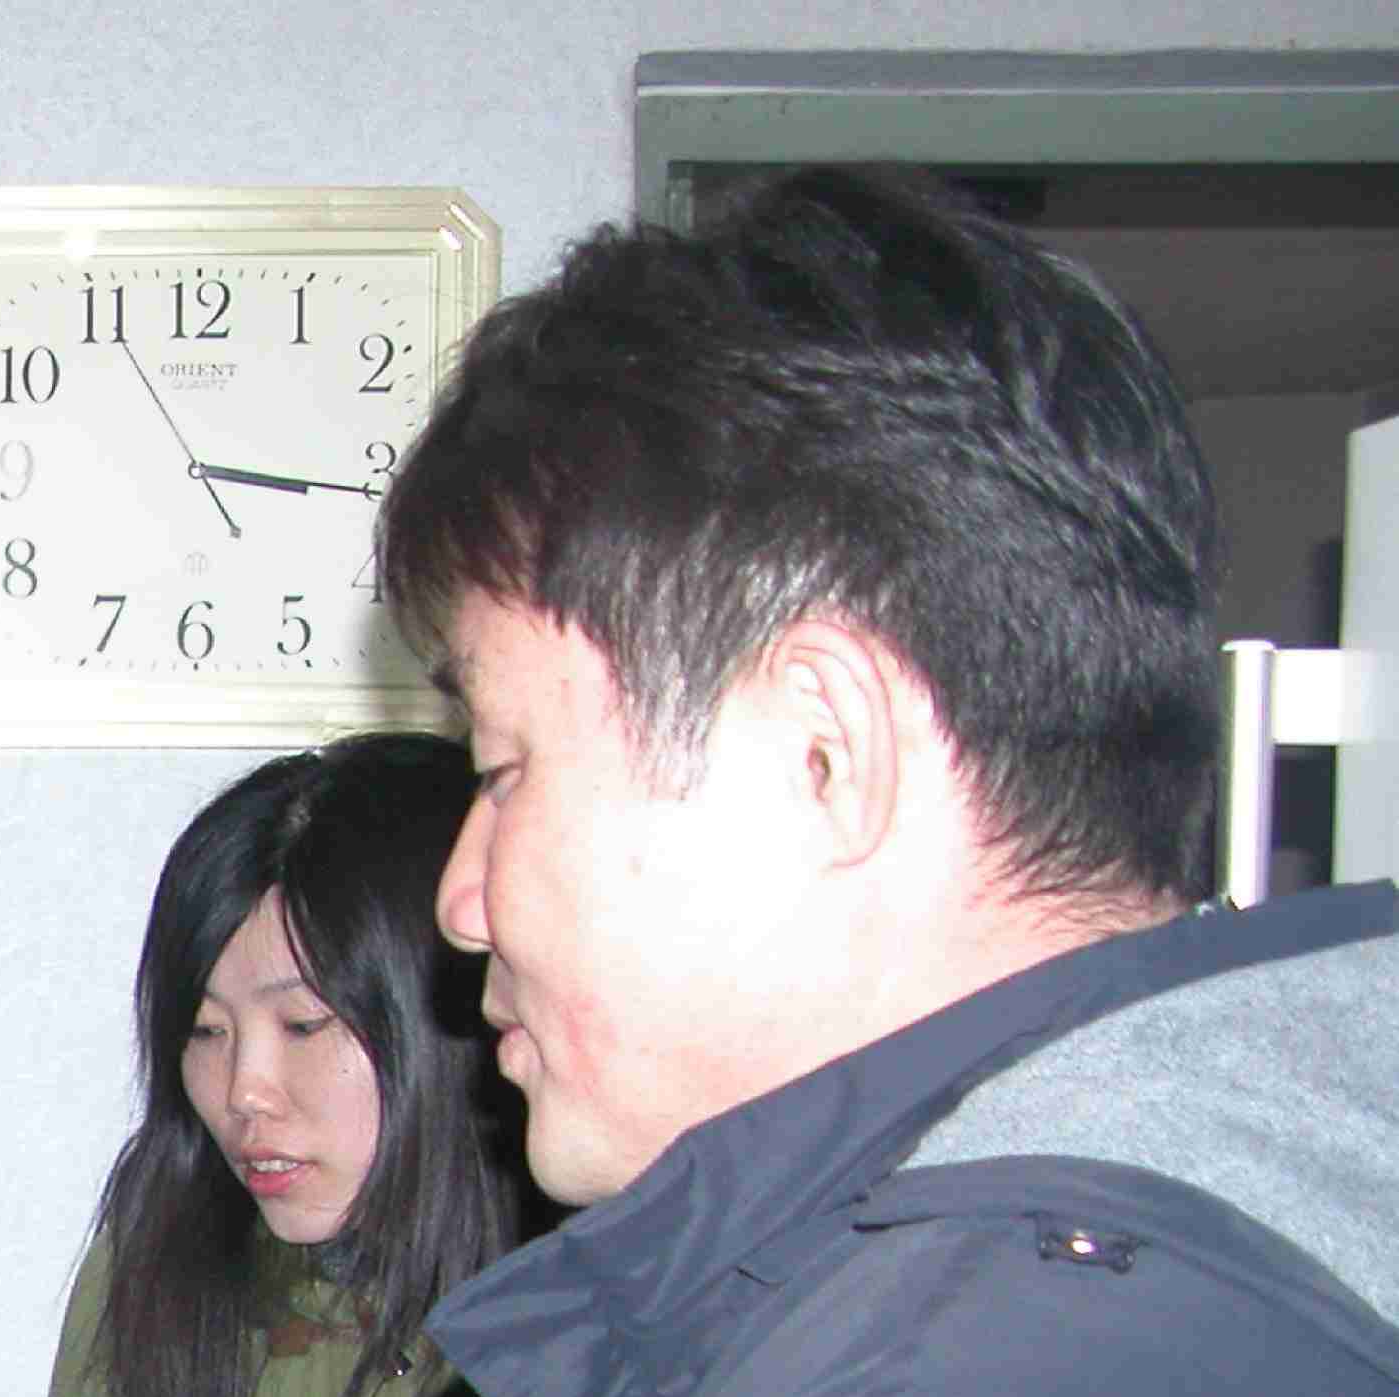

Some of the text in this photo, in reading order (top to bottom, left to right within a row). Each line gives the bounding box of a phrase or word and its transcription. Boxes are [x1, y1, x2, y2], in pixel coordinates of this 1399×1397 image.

[82, 286, 129, 344] 11
[169, 281, 231, 339] 12
[290, 286, 311, 344] 1
[0, 346, 60, 403] 10
[161, 363, 237, 377] ORIENT
[358, 334, 395, 393] 2
[3, 538, 37, 598] 8
[93, 595, 126, 653] 7
[177, 601, 215, 660] 6
[276, 596, 311, 655] 5
